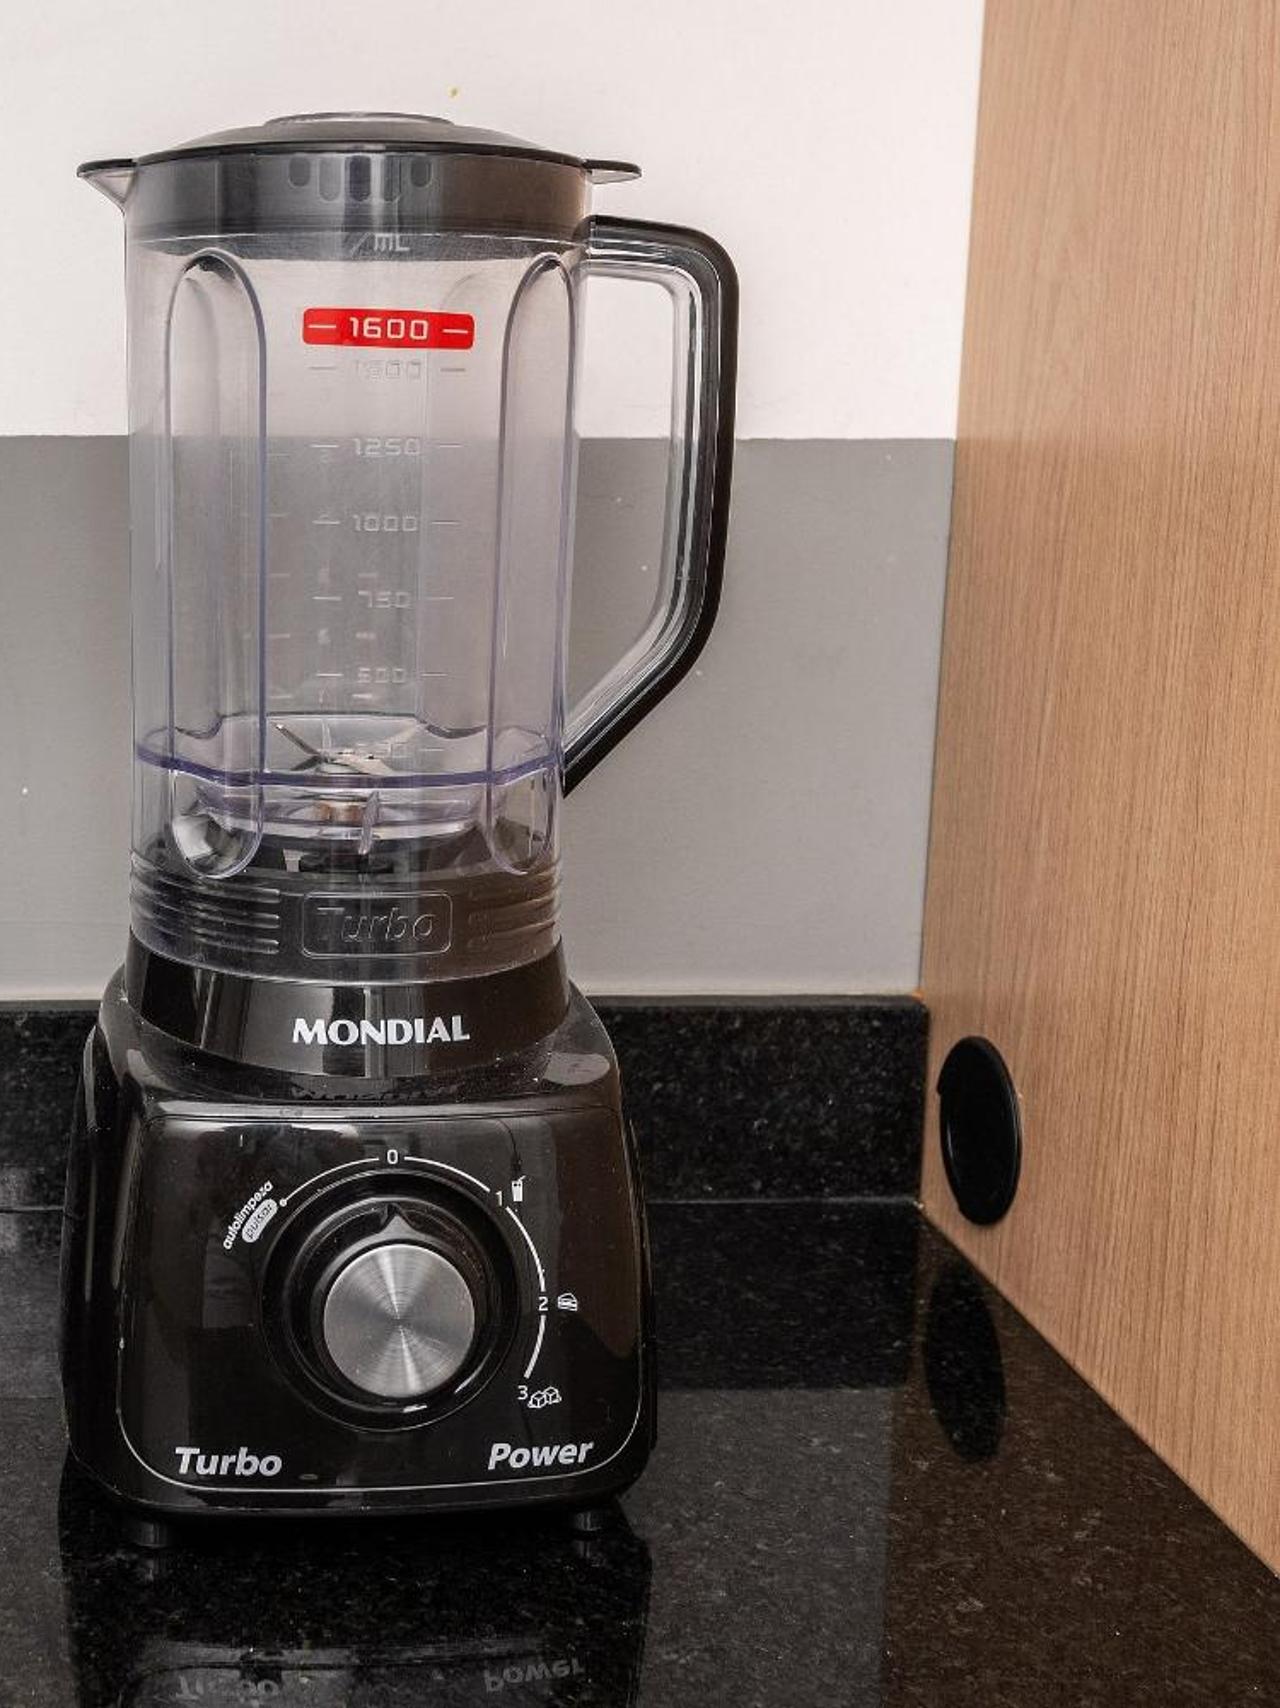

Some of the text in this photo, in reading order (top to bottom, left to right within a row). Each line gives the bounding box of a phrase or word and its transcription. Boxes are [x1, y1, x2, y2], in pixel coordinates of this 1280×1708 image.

[349, 317, 429, 340] 1600
[353, 438, 421, 456] 1250
[353, 514, 418, 532] 1000
[358, 591, 412, 608] 750
[358, 667, 407, 683] 500
[317, 907, 436, 942] Turbo
[291, 1016, 471, 1046] MONDIAL
[386, 1149, 399, 1165] 0
[495, 1190, 504, 1206] 1
[538, 1297, 549, 1311] 2
[517, 1385, 528, 1400] 3
[175, 1446, 283, 1477] Turbo
[488, 1441, 594, 1470] Power
